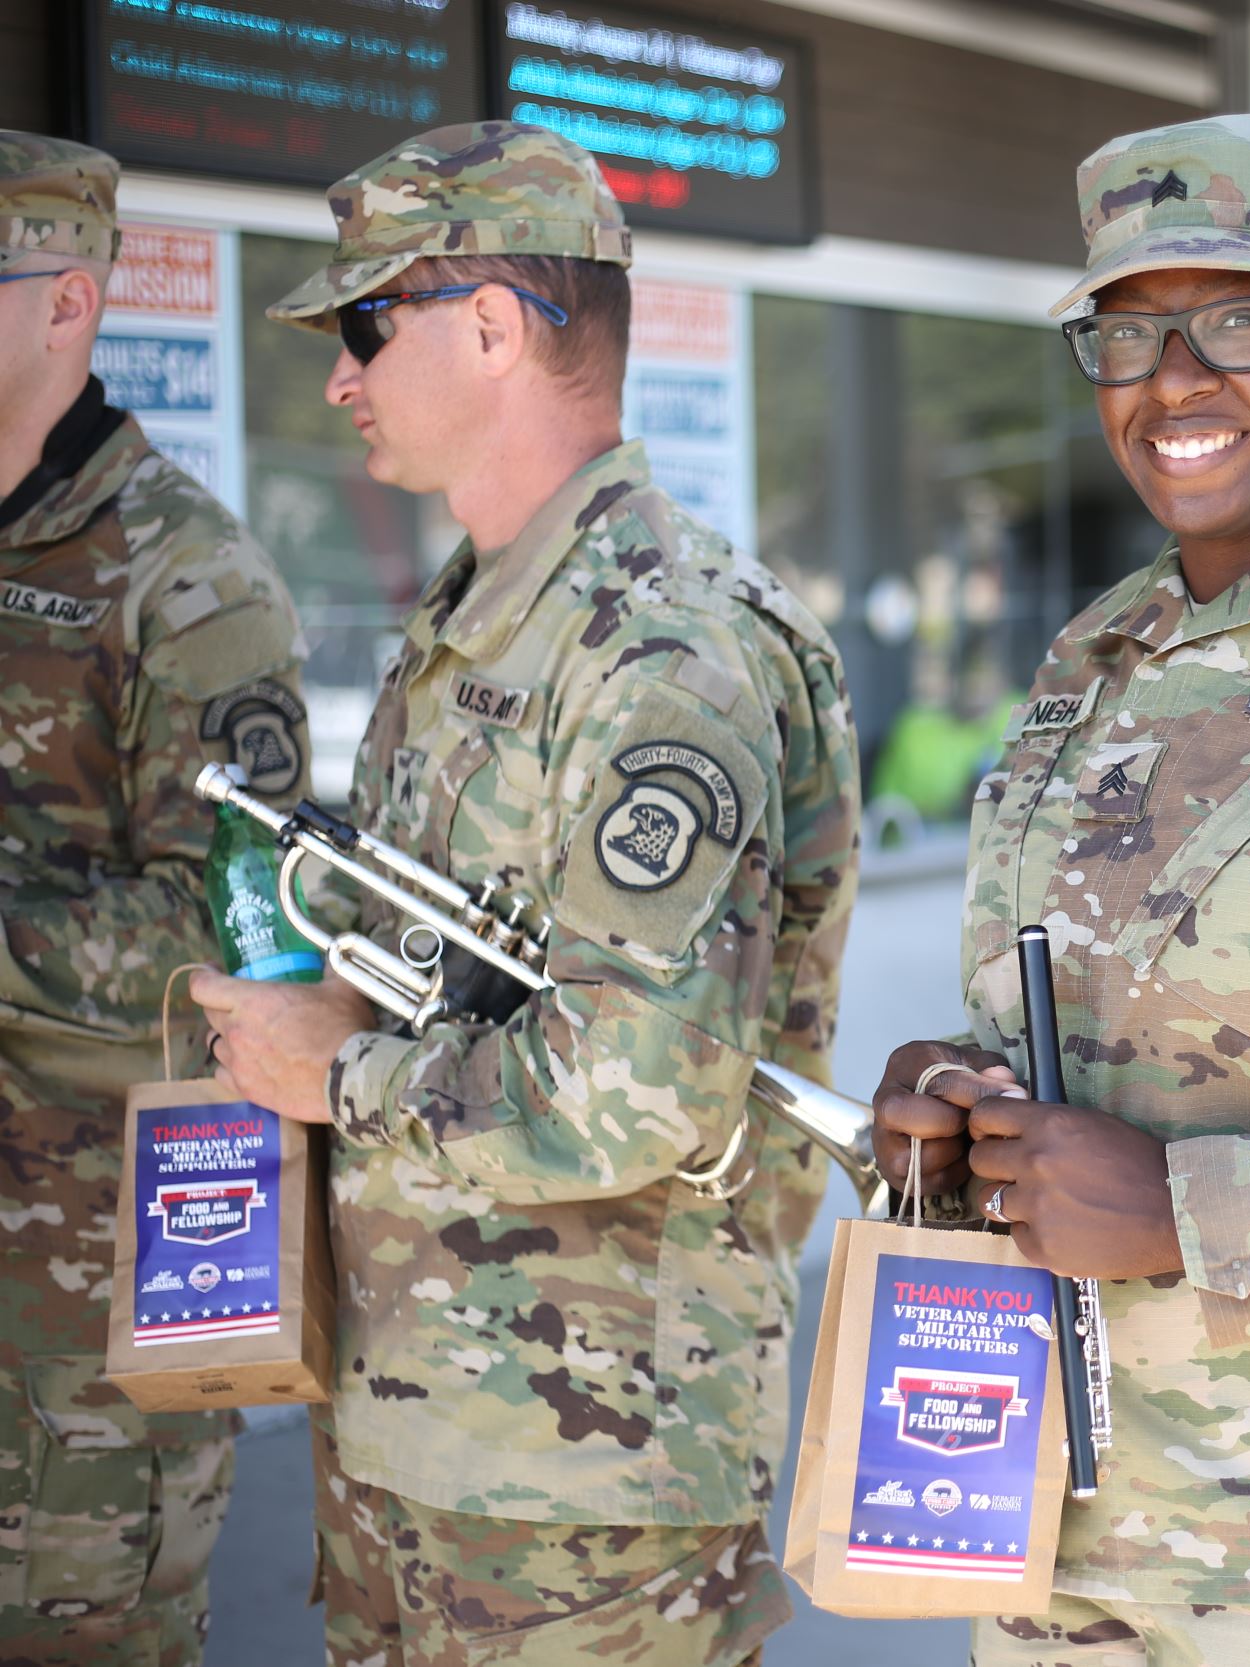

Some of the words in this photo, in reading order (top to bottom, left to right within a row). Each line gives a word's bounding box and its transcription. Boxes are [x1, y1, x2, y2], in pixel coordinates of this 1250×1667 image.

[3, 587, 36, 613] U.S.
[457, 682, 492, 717] U.S.
[623, 748, 709, 773] THIRTY-FOURTH
[708, 772, 731, 803] ARMY
[152, 1123, 219, 1143] THANK
[223, 1119, 263, 1137] YOU
[153, 1138, 230, 1155] VETERANS
[233, 1136, 264, 1151] AND
[173, 1148, 243, 1163] MILITARY
[158, 1157, 257, 1174] SUPPORTERS
[182, 1202, 211, 1215] FOOD
[171, 1210, 243, 1229] FELLOWSHIP
[894, 1282, 979, 1308] THANK
[982, 1289, 1034, 1312] YOU
[893, 1304, 989, 1325] VETERANS
[992, 1313, 1030, 1328] AND
[915, 1320, 1005, 1340] MILITARY
[898, 1333, 1020, 1356] SUPPORTERS
[930, 1381, 980, 1394] PROJECT
[924, 1398, 959, 1414] FOOD
[962, 1403, 983, 1414] AND
[909, 1413, 997, 1434] FELLOWSHIP
